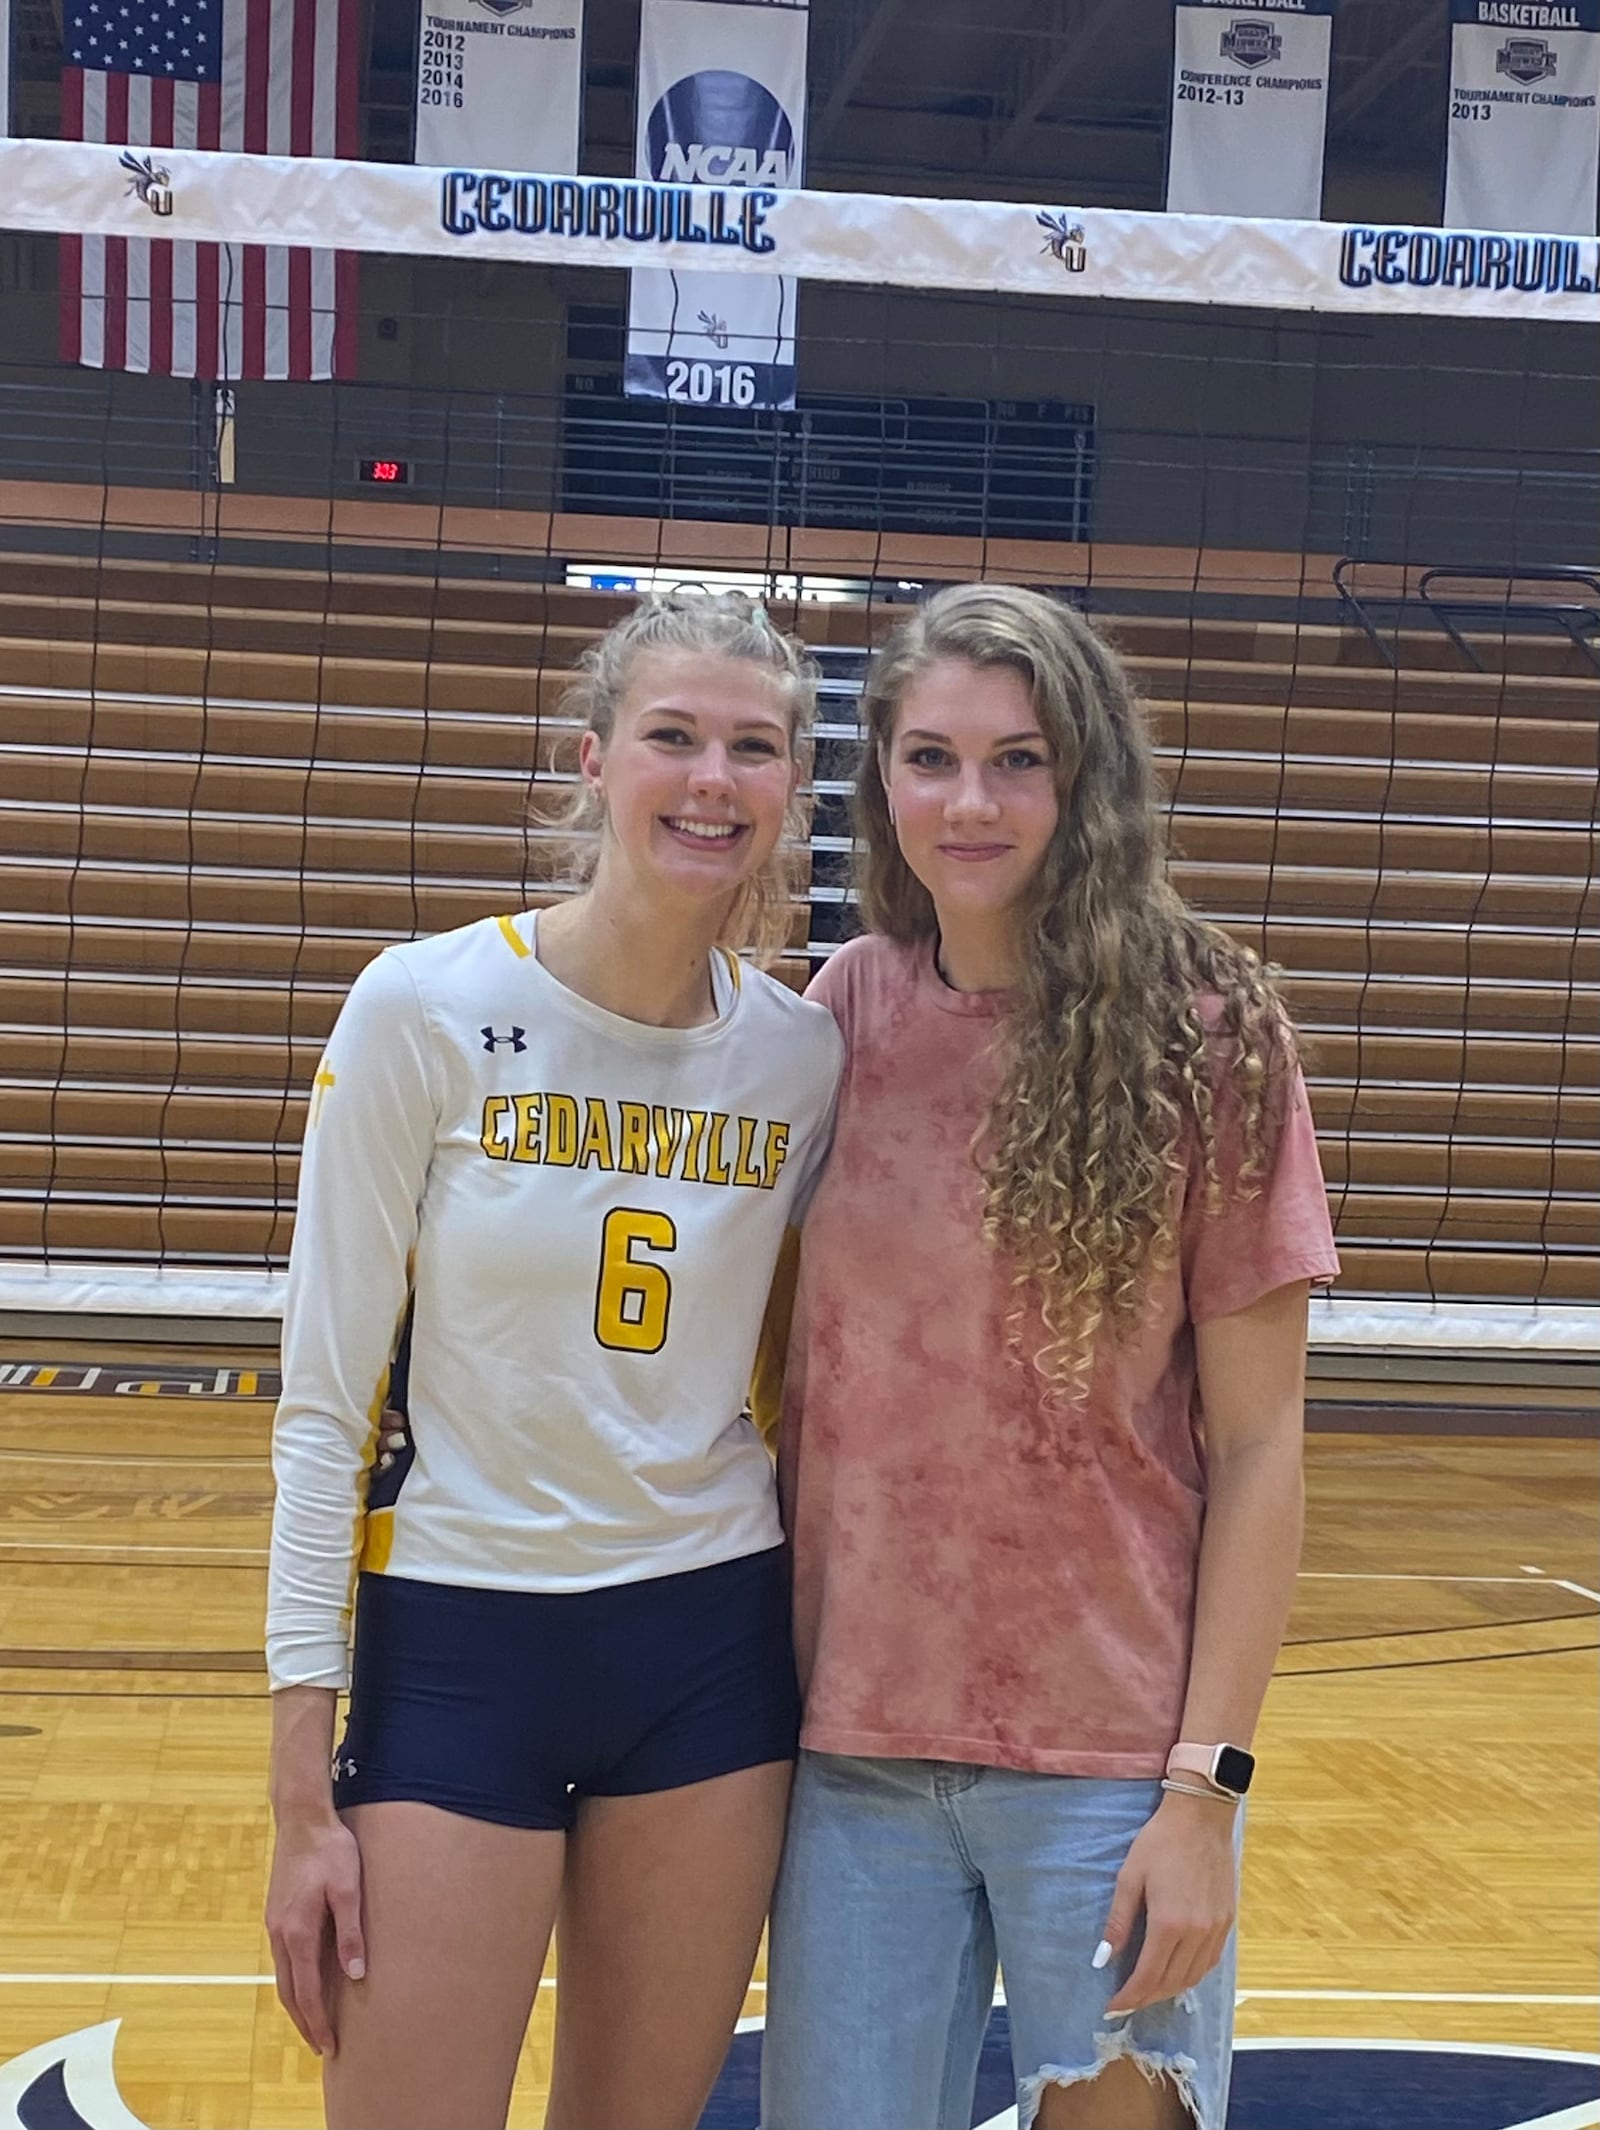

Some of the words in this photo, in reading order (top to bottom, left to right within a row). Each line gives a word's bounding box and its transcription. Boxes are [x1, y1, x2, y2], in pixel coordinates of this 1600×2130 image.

[1478, 1, 1581, 27] BASKETBALL
[426, 15, 505, 36] TOURNAMENT
[507, 24, 576, 40] CHAMPIONS
[424, 31, 465, 51] 2012
[423, 50, 463, 71] 2013
[422, 69, 463, 90] 2014
[1180, 69, 1252, 87] CONFERENCE
[1256, 75, 1322, 90] CHAMPIONS
[421, 87, 463, 109] 2016
[1177, 83, 1244, 106] 2012-13
[1454, 88, 1530, 105] TOURNAMENT
[1532, 92, 1596, 108] CHAMPIONS
[1452, 102, 1491, 121] 2013
[659, 142, 789, 188] NCAA
[442, 171, 777, 254] CEDARVILLE
[1340, 228, 1600, 294] CEDARVIL
[666, 360, 756, 406] 2016
[480, 1092, 790, 1190] CEDARVILLE
[594, 1206, 677, 1355] 6
